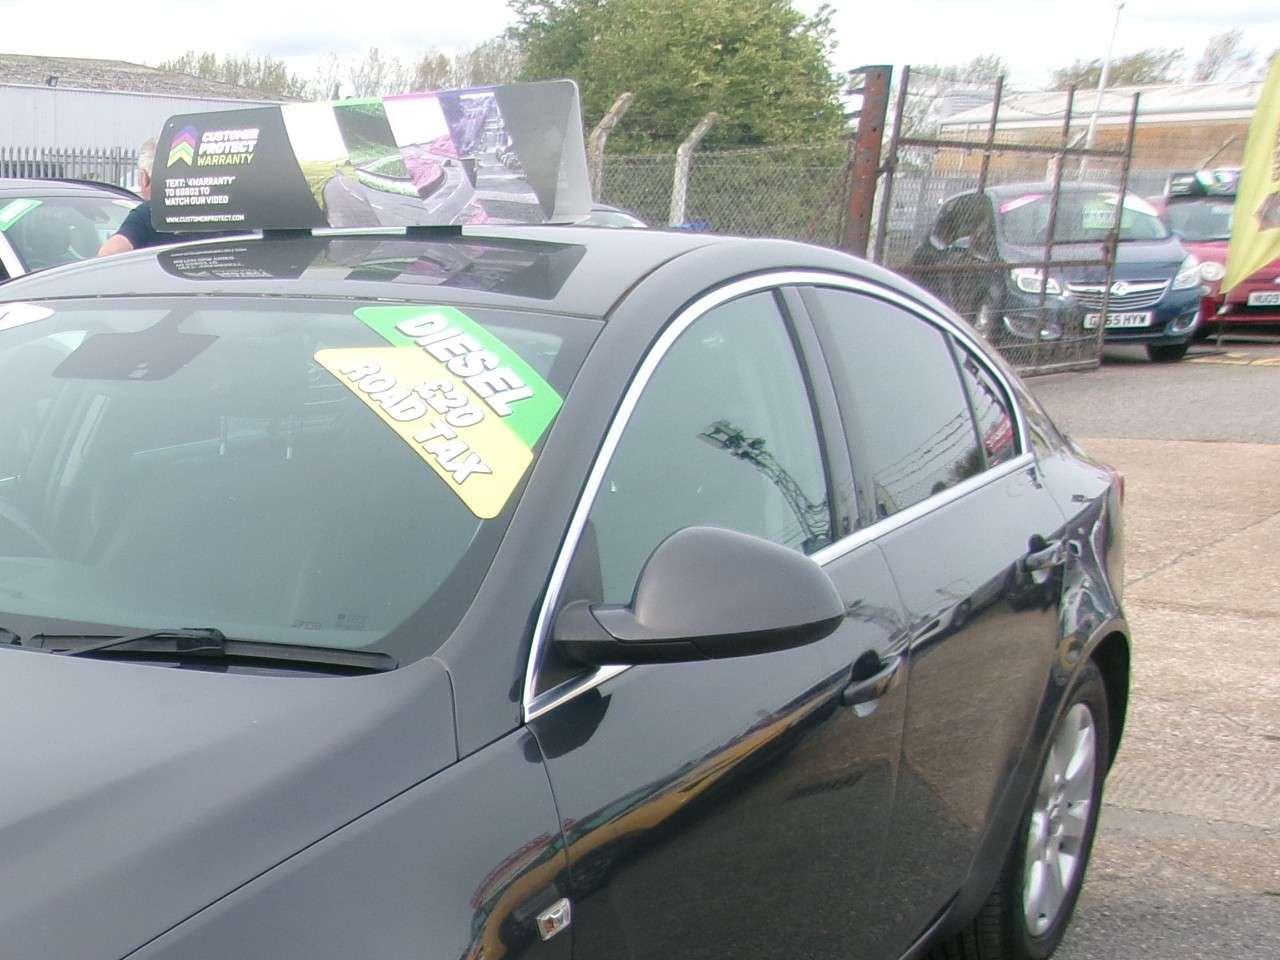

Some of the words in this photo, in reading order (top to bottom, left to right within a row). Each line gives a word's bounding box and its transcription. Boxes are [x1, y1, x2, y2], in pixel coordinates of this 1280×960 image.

[202, 128, 259, 143] CUSTOMER
[199, 140, 258, 155] PROTECT
[197, 153, 254, 167] WARRANTY
[165, 188, 175, 197] TO
[200, 187, 210, 195] TO
[164, 197, 190, 206] WATCH
[191, 196, 206, 205] OUR
[206, 195, 229, 204] VIDEO
[395, 313, 534, 417] DIESEL
[413, 380, 485, 428] £20
[338, 361, 428, 422] ROAD
[412, 418, 493, 485] TAX
